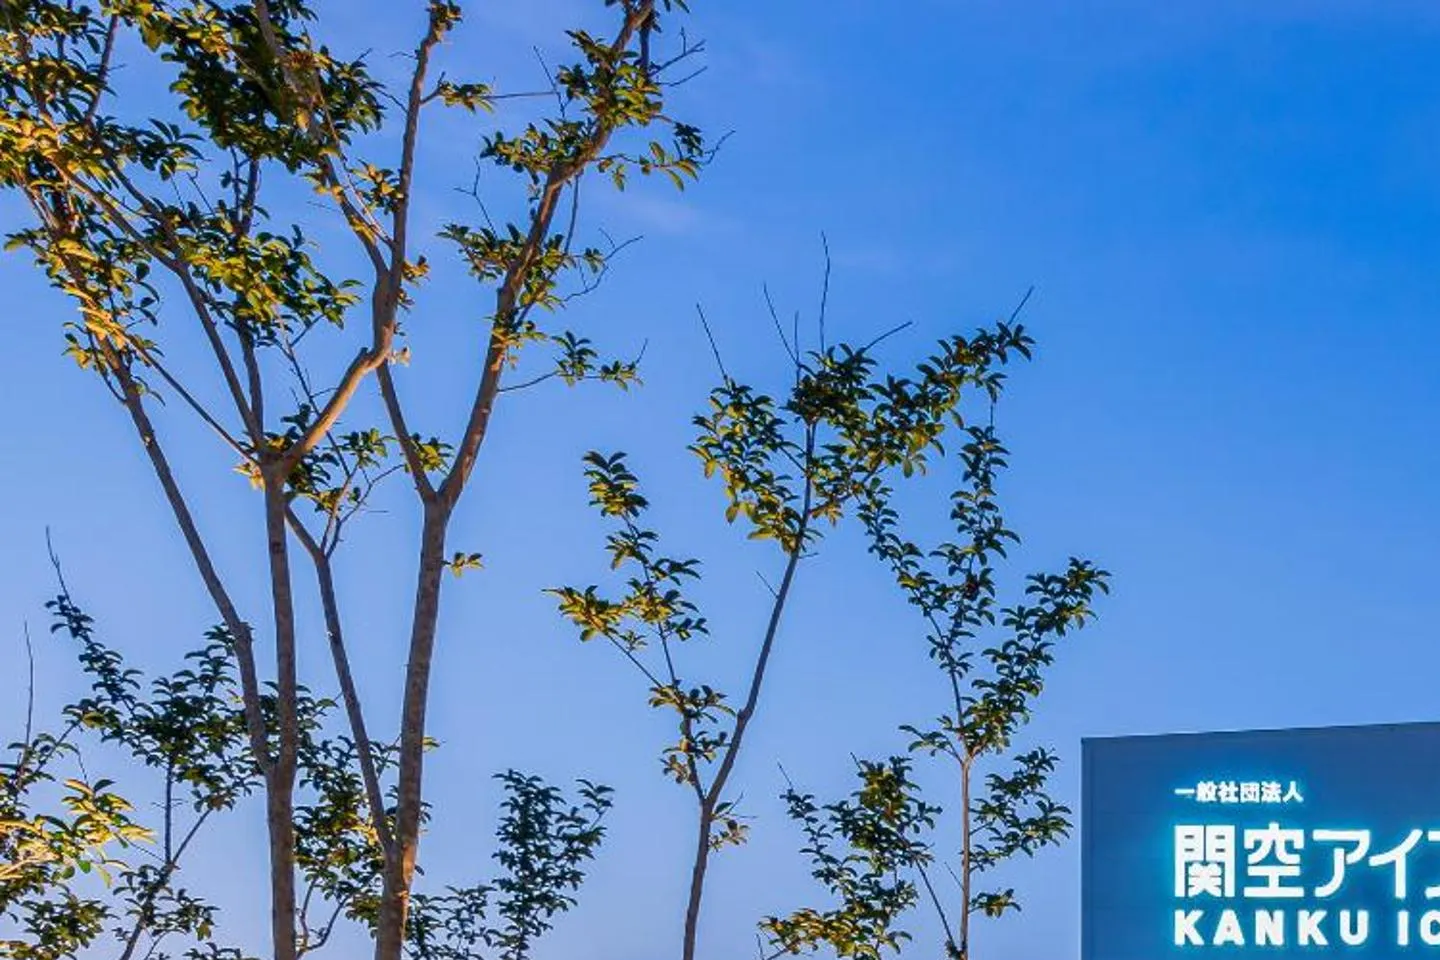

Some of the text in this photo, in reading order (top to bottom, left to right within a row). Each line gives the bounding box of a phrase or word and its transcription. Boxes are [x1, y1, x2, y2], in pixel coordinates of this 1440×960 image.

[1174, 781, 1304, 803] 一般社団法人
[1174, 909, 1370, 946] KANKU
